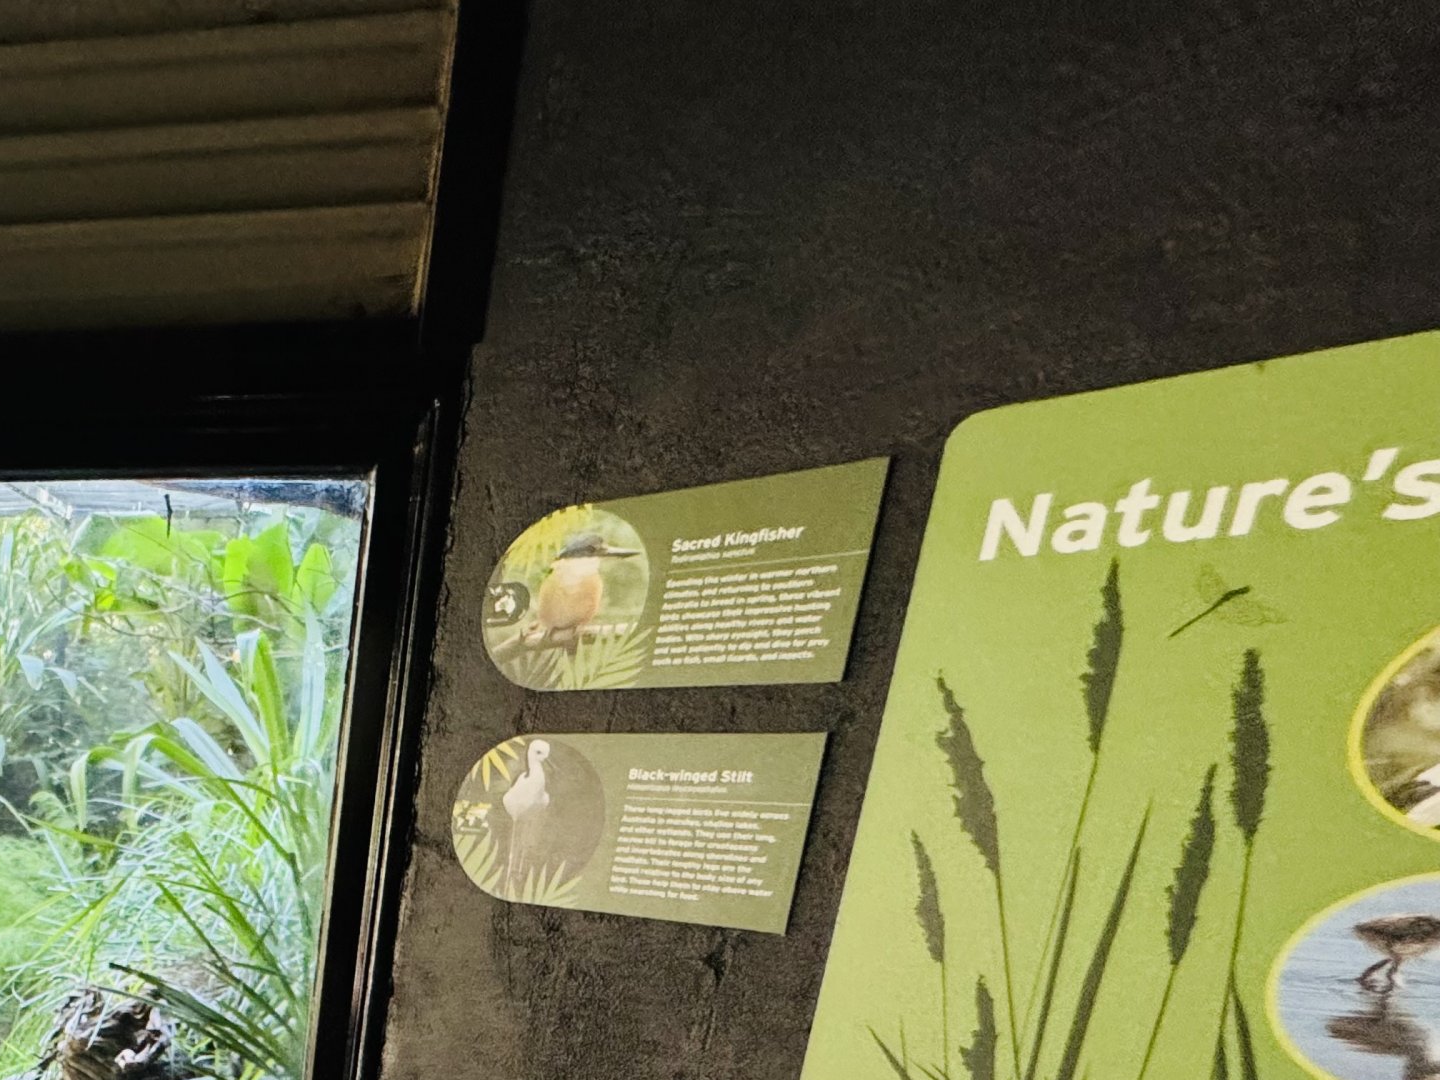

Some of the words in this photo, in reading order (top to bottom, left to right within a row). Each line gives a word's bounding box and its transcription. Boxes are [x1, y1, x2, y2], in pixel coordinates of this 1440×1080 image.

[979, 447, 1440, 561] Nature's
[672, 535, 721, 552] Sacred
[724, 526, 806, 546] Kingfisher
[629, 768, 717, 783] Black-winged
[720, 770, 753, 783] Stilt
